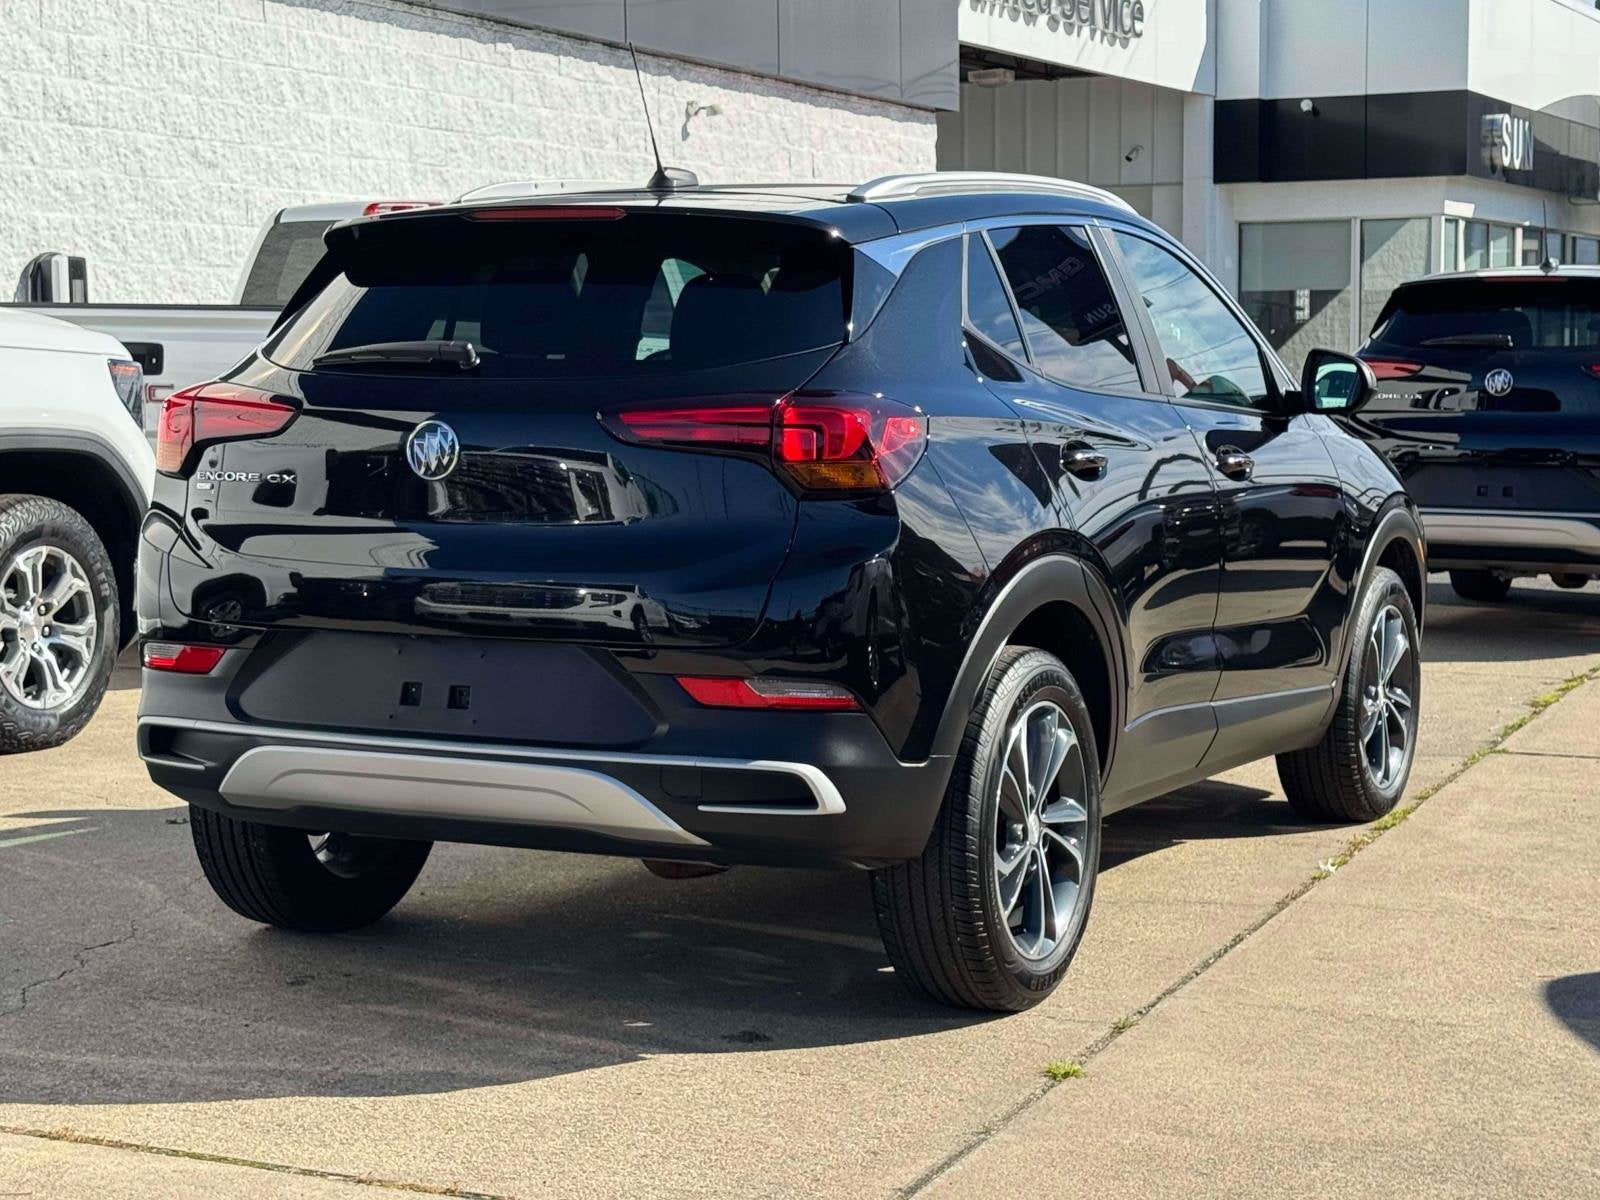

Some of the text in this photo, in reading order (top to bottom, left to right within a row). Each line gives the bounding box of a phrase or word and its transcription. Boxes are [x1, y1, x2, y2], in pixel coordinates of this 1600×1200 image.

[1501, 113, 1534, 171] SUN
[197, 471, 297, 484] ENCORE GX
